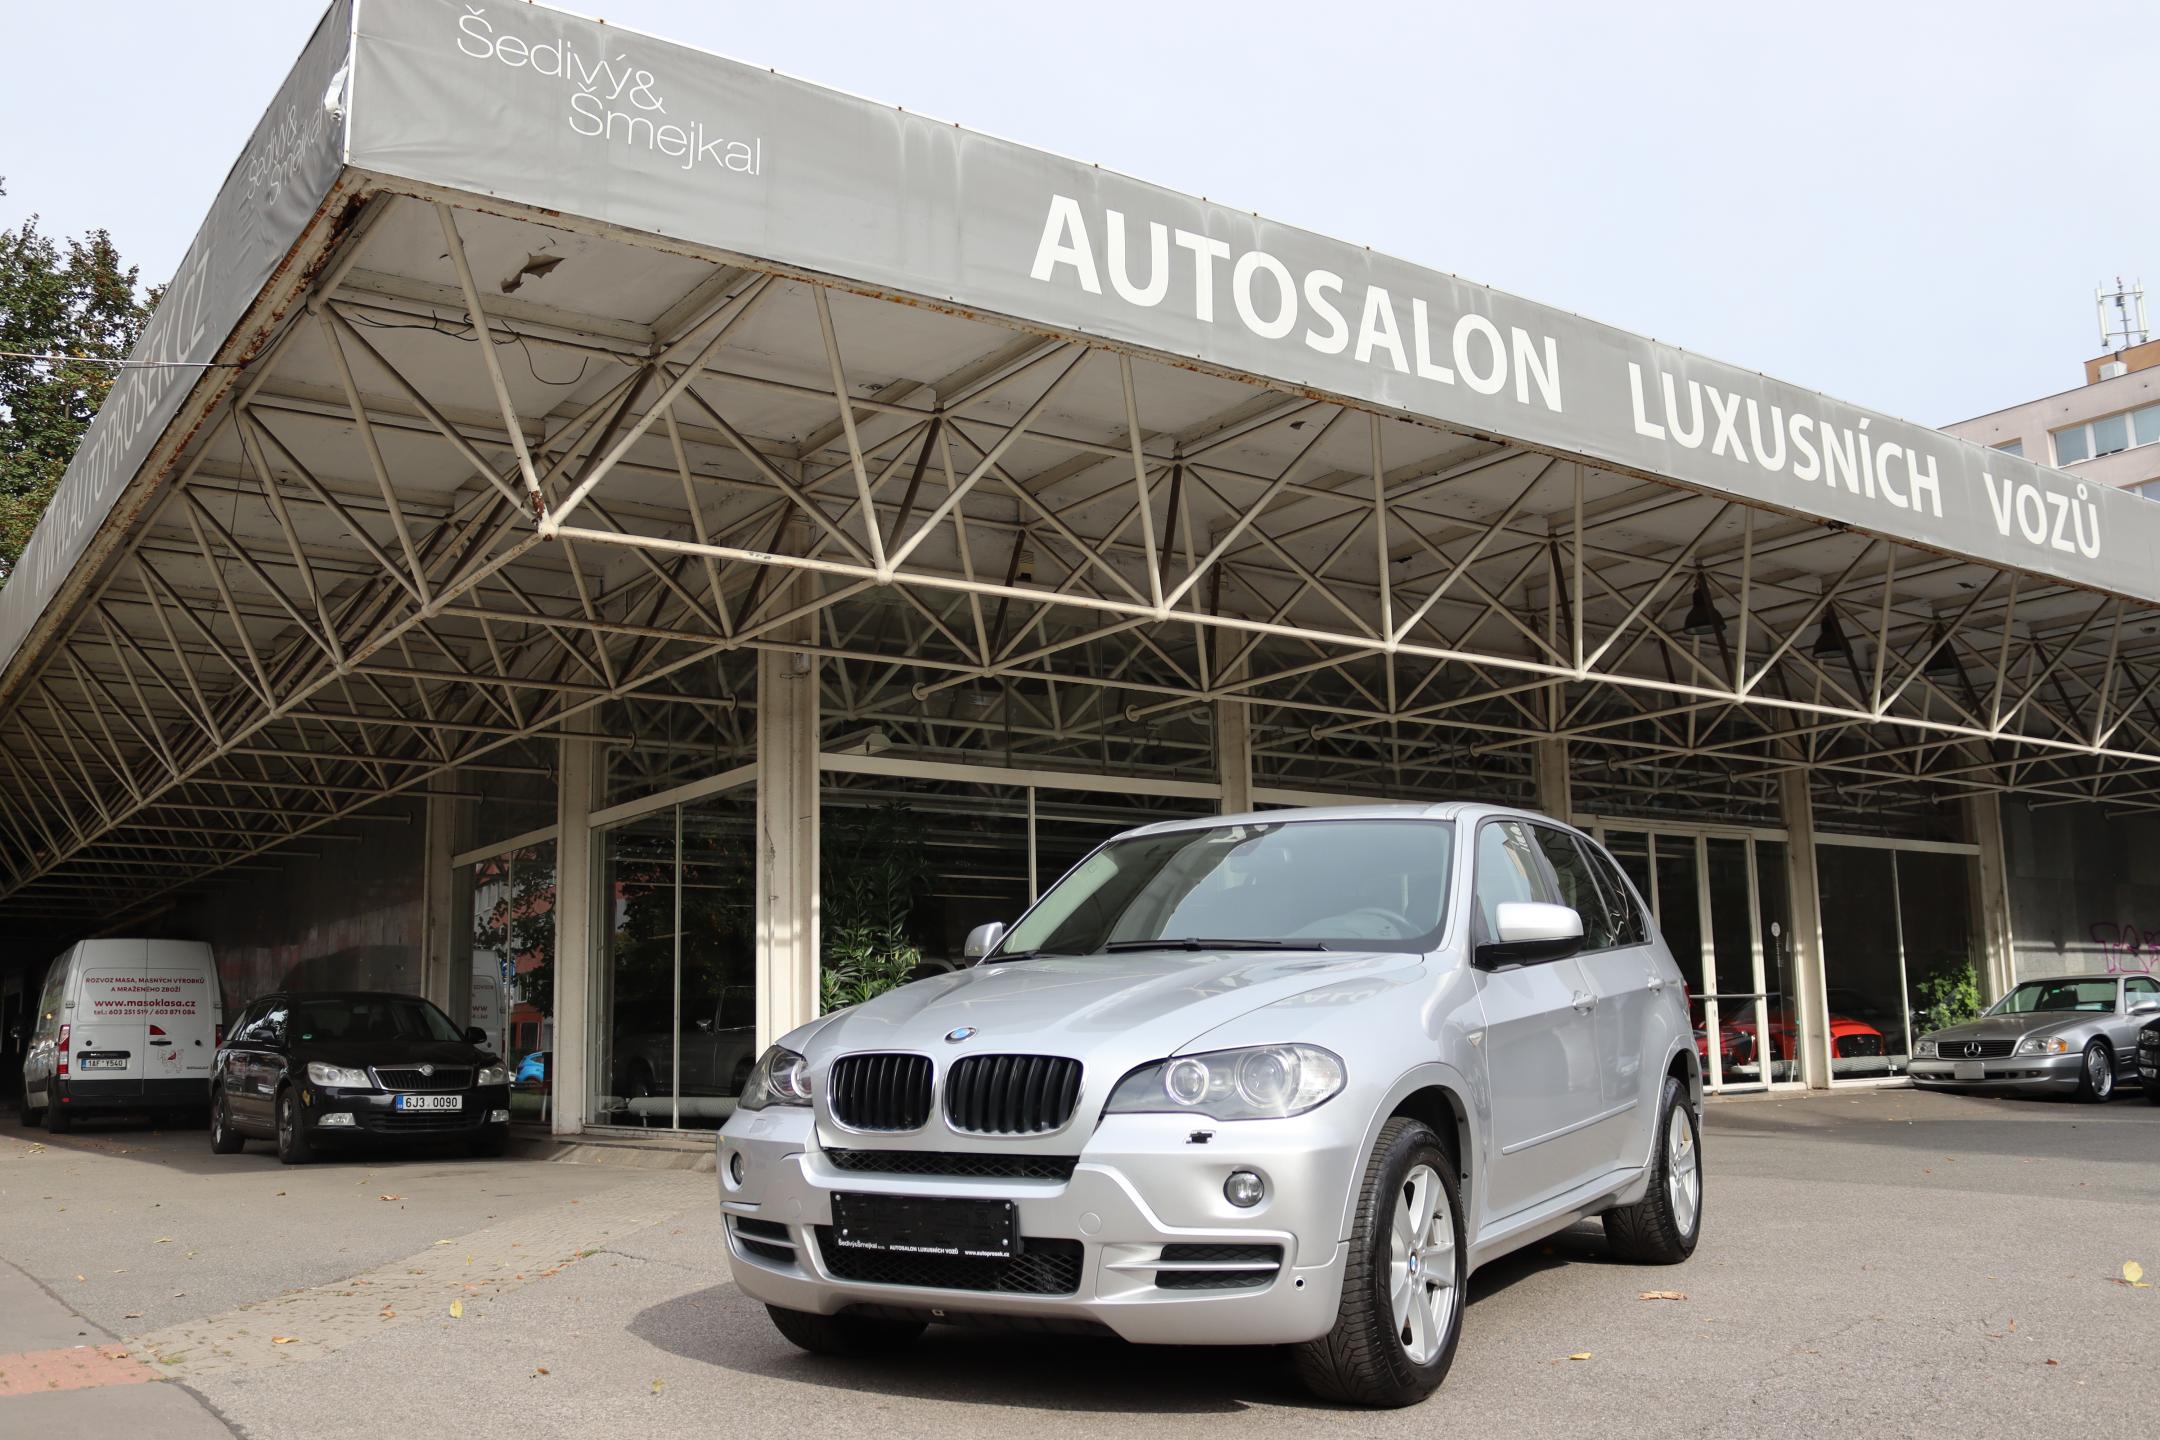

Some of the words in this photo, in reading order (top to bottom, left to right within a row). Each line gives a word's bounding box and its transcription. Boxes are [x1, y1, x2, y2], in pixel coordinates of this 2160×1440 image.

[457, 4, 666, 114] Šedivý&
[569, 82, 760, 175] Šmejkal
[1030, 194, 1562, 412] AUTOSALON
[1628, 362, 1943, 518] LUXUSNÍCH
[1984, 483, 2100, 559] VOZŮ
[94, 998, 196, 1007] www.masoklasa.cz
[405, 1097, 425, 1108] 6J3
[432, 1097, 458, 1108] 0090
[889, 1244, 917, 1252] AUTOSALON
